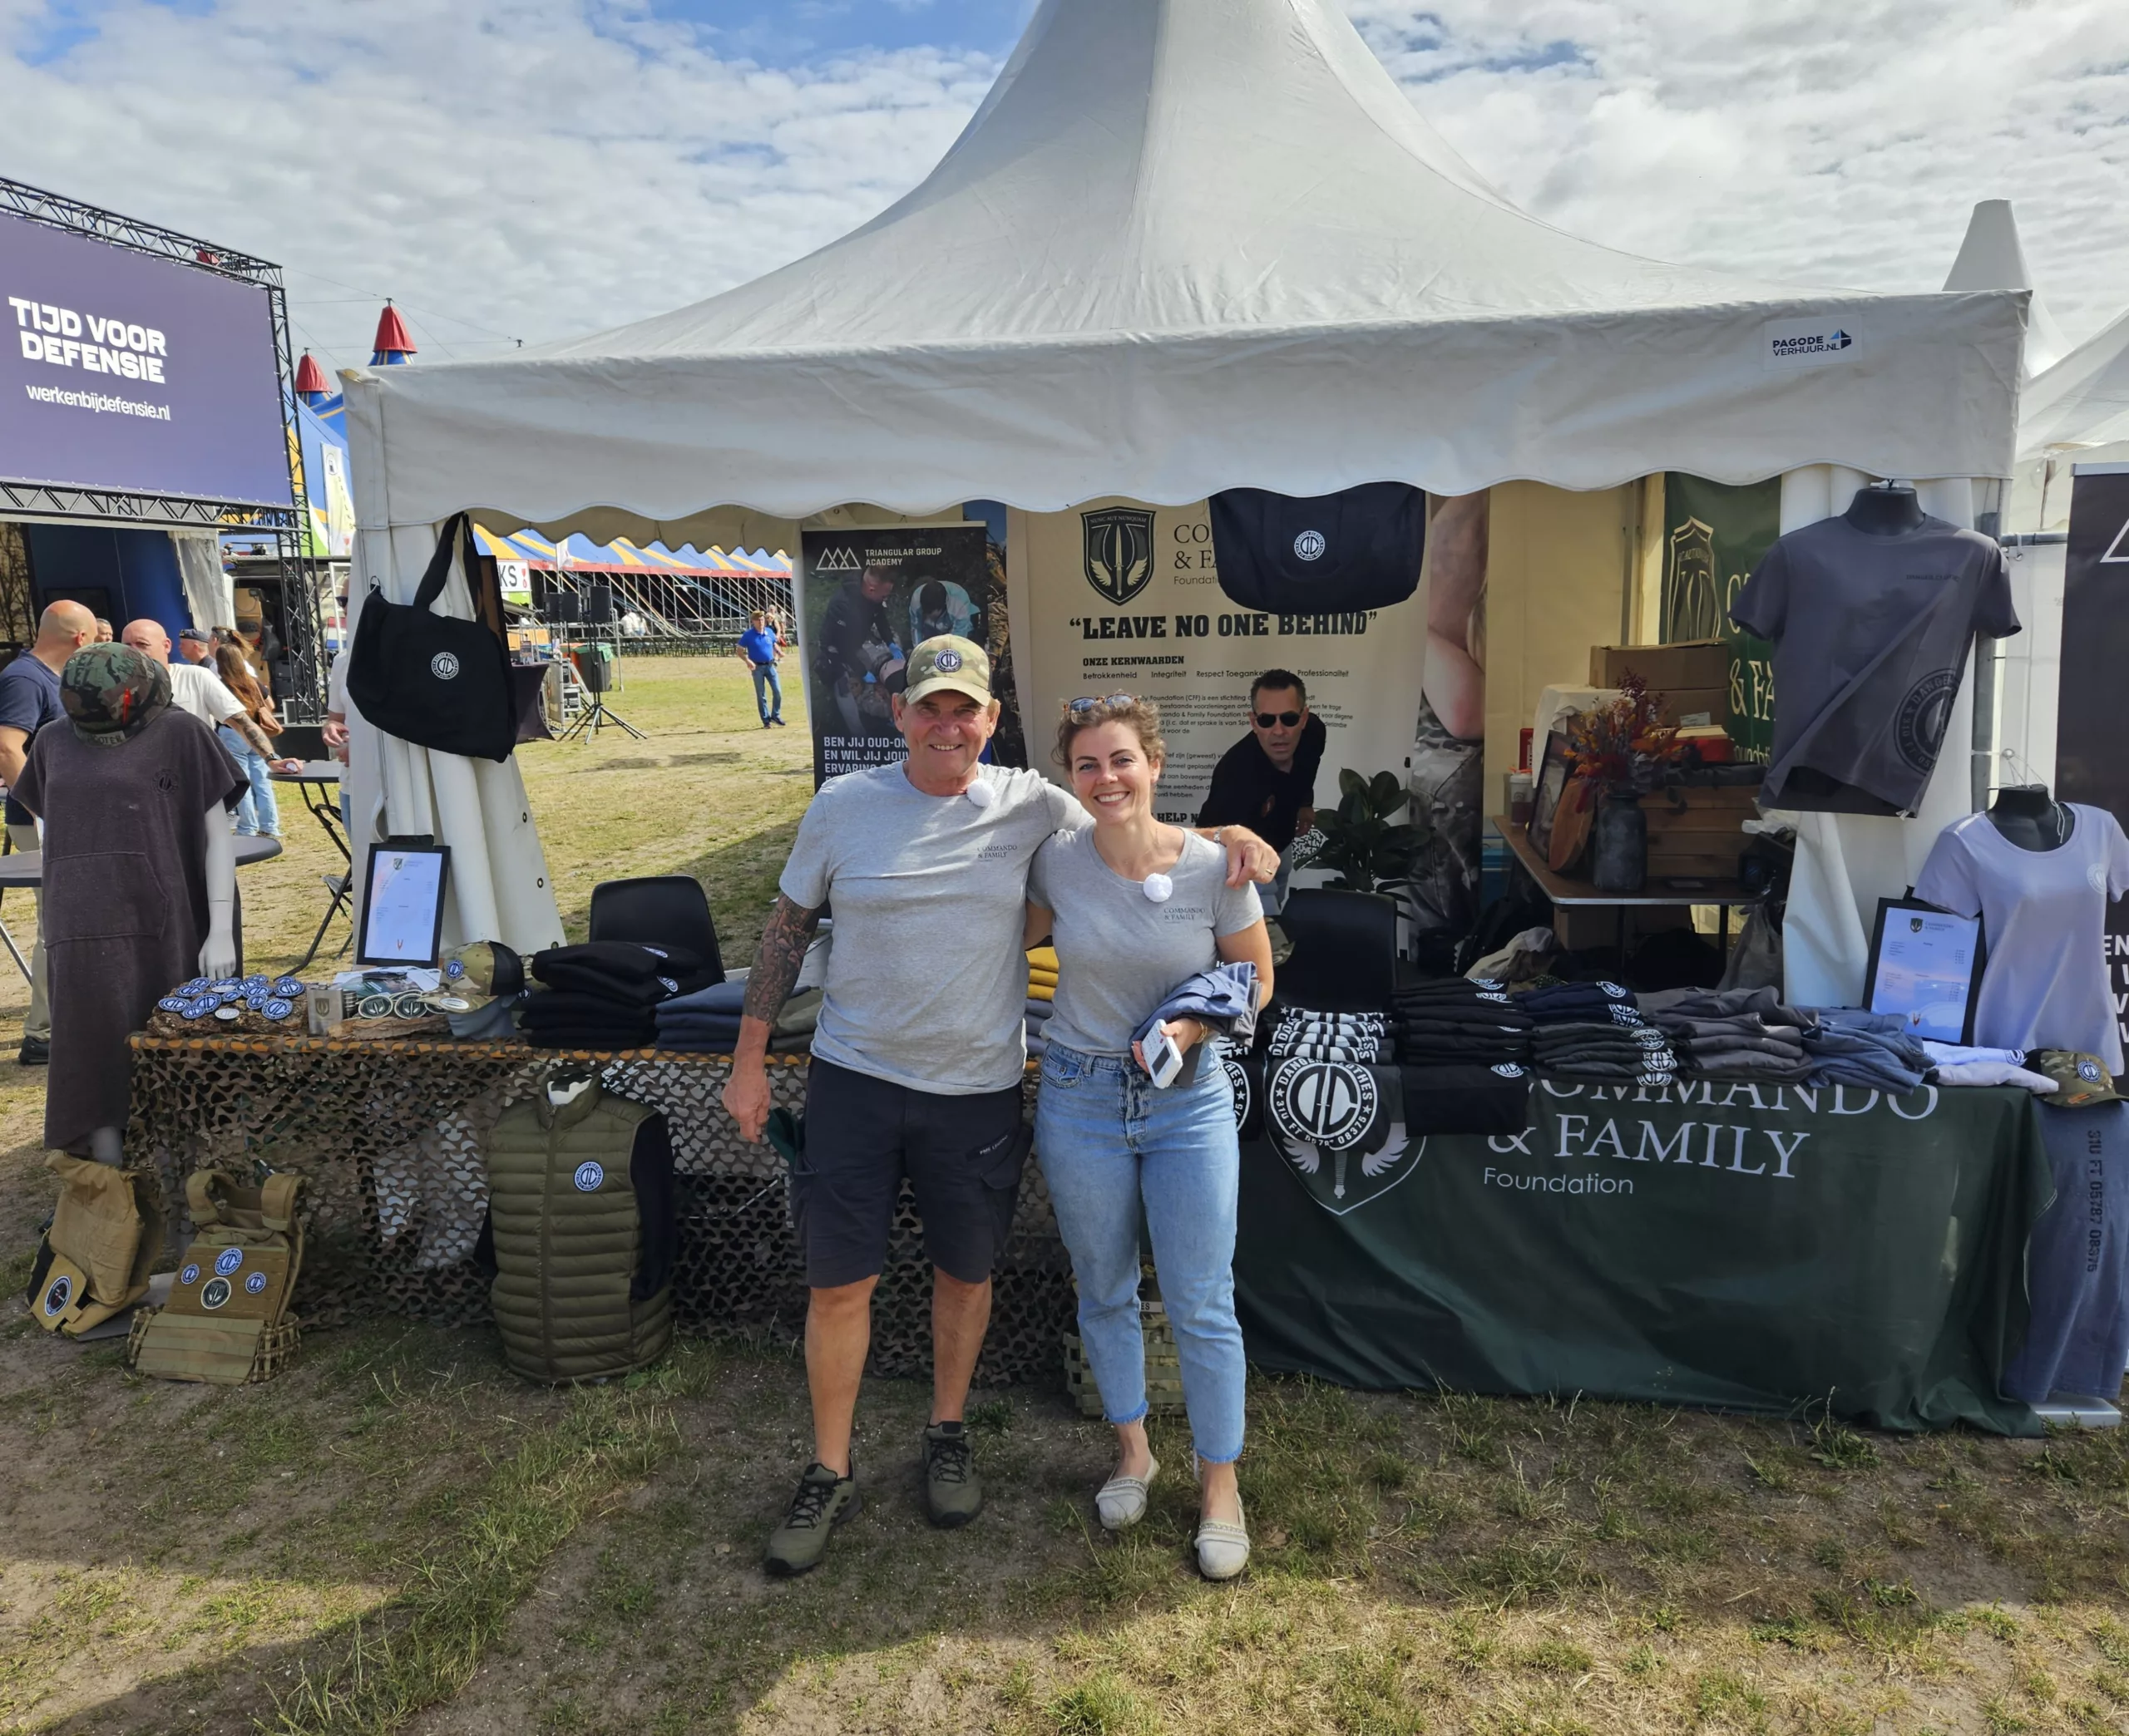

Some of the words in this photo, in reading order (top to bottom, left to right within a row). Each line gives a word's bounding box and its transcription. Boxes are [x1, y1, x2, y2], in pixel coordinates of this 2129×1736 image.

[8, 296, 82, 338] TIJD
[86, 314, 168, 357] VOOR
[1772, 335, 1824, 348] PAGODE
[1773, 343, 1840, 356] VERHUUR.NL
[20, 330, 165, 384] DEFENSIE
[26, 384, 171, 421] werkenbijdefensie.nl
[1173, 524, 1213, 544] CO
[865, 548, 914, 557] TRIANGULAR
[916, 547, 942, 555] GROUP
[865, 558, 903, 566] ACADEMY
[1174, 550, 1193, 570] &
[1175, 614, 1209, 637] NO
[1218, 613, 1269, 636] ONE
[1082, 657, 1109, 667] ONZE
[1110, 655, 1185, 666] KERNWAARDEN
[1082, 671, 1138, 679] Betrokkenheid
[1151, 670, 1187, 679] Integriteit
[1196, 669, 1224, 678] Respect
[1297, 668, 1349, 678] Professionaliteit
[823, 737, 845, 747] BEN
[847, 737, 864, 747] JIJ
[824, 750, 837, 760] EN
[841, 750, 861, 760] WIL
[863, 750, 880, 761] JIJ
[1157, 812, 1188, 823] HELP
[1288, 1122, 1303, 1135] FT
[1554, 1112, 1810, 1179] FAMILY
[2089, 1160, 2102, 1176] FT
[1483, 1167, 1635, 1195] Foundation
[2089, 1181, 2103, 1225] 05787
